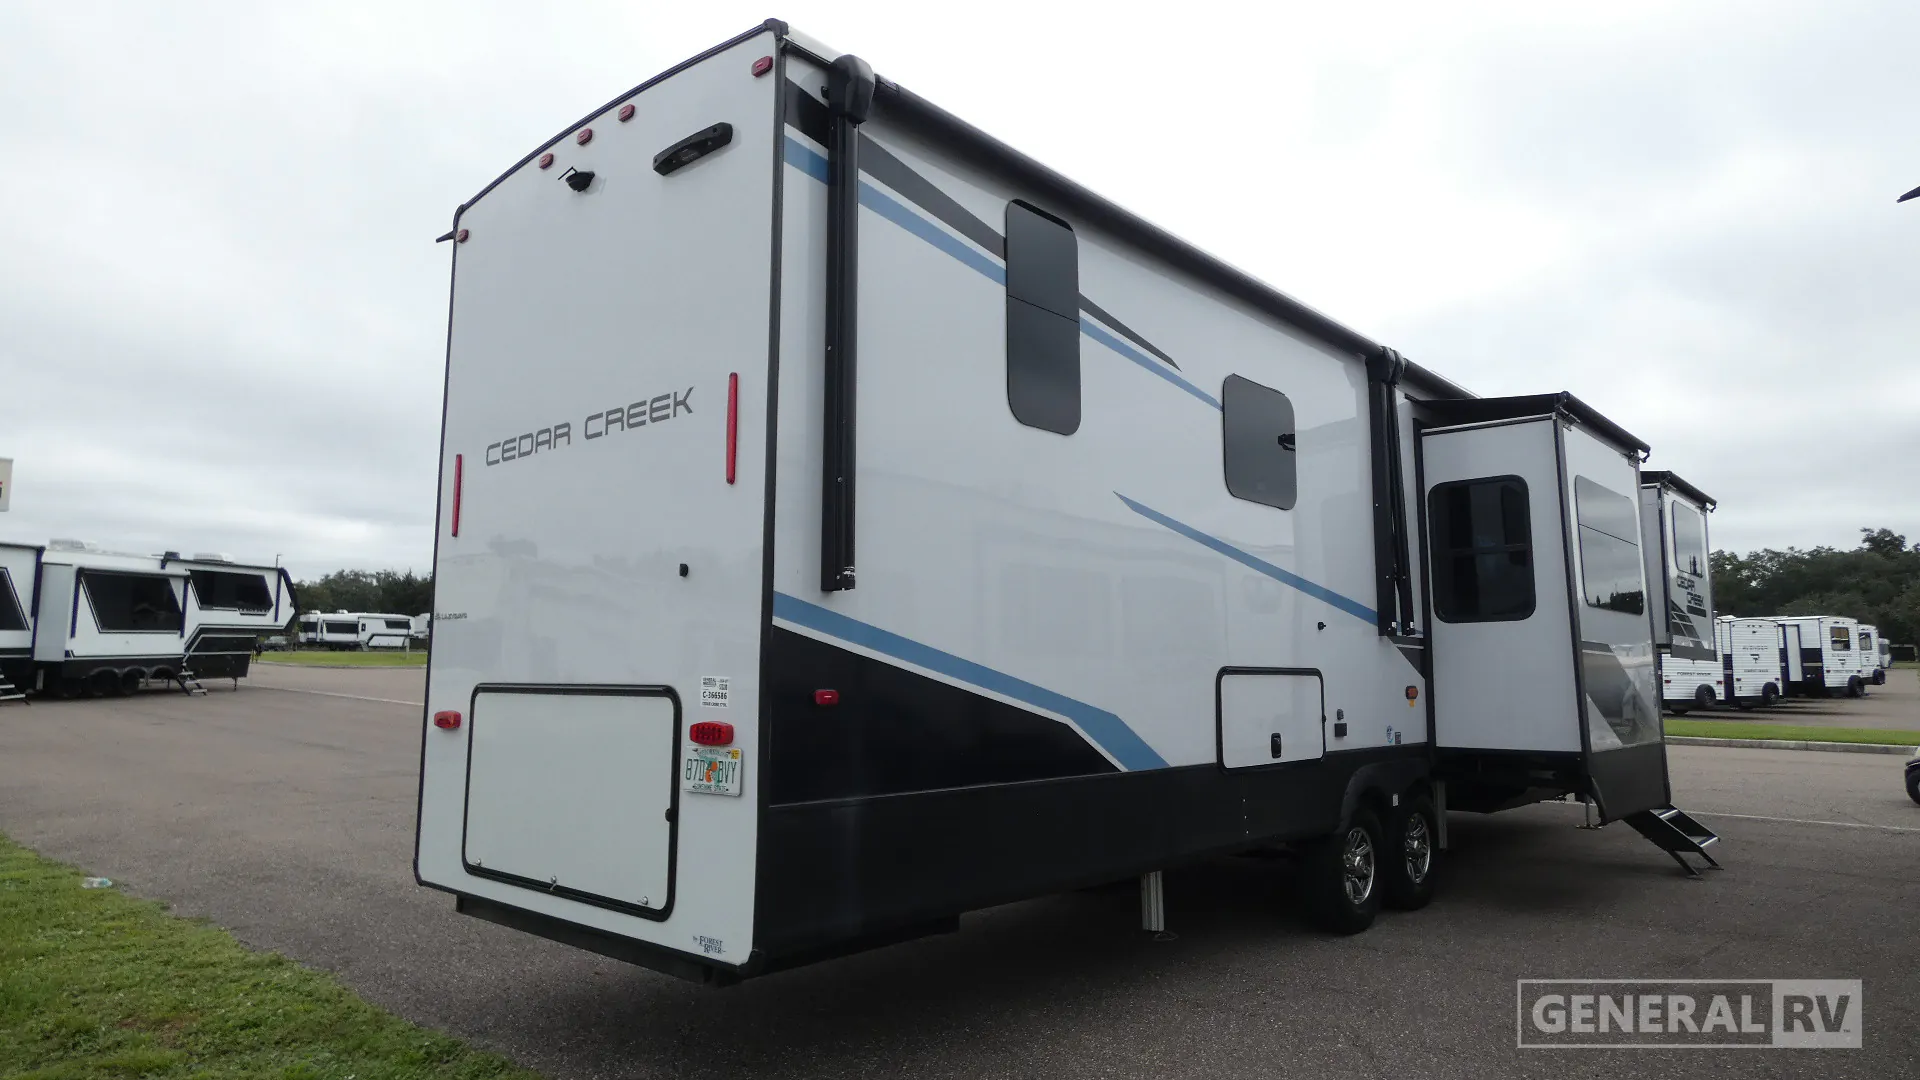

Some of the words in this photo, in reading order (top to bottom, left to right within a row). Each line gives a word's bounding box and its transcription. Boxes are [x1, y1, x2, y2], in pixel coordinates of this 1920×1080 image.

[486, 422, 571, 467] CEDAR
[584, 387, 694, 440] CREEK
[1677, 575, 1695, 592] CEDAR
[699, 935, 723, 947] FOREST
[704, 944, 722, 954] RIVER
